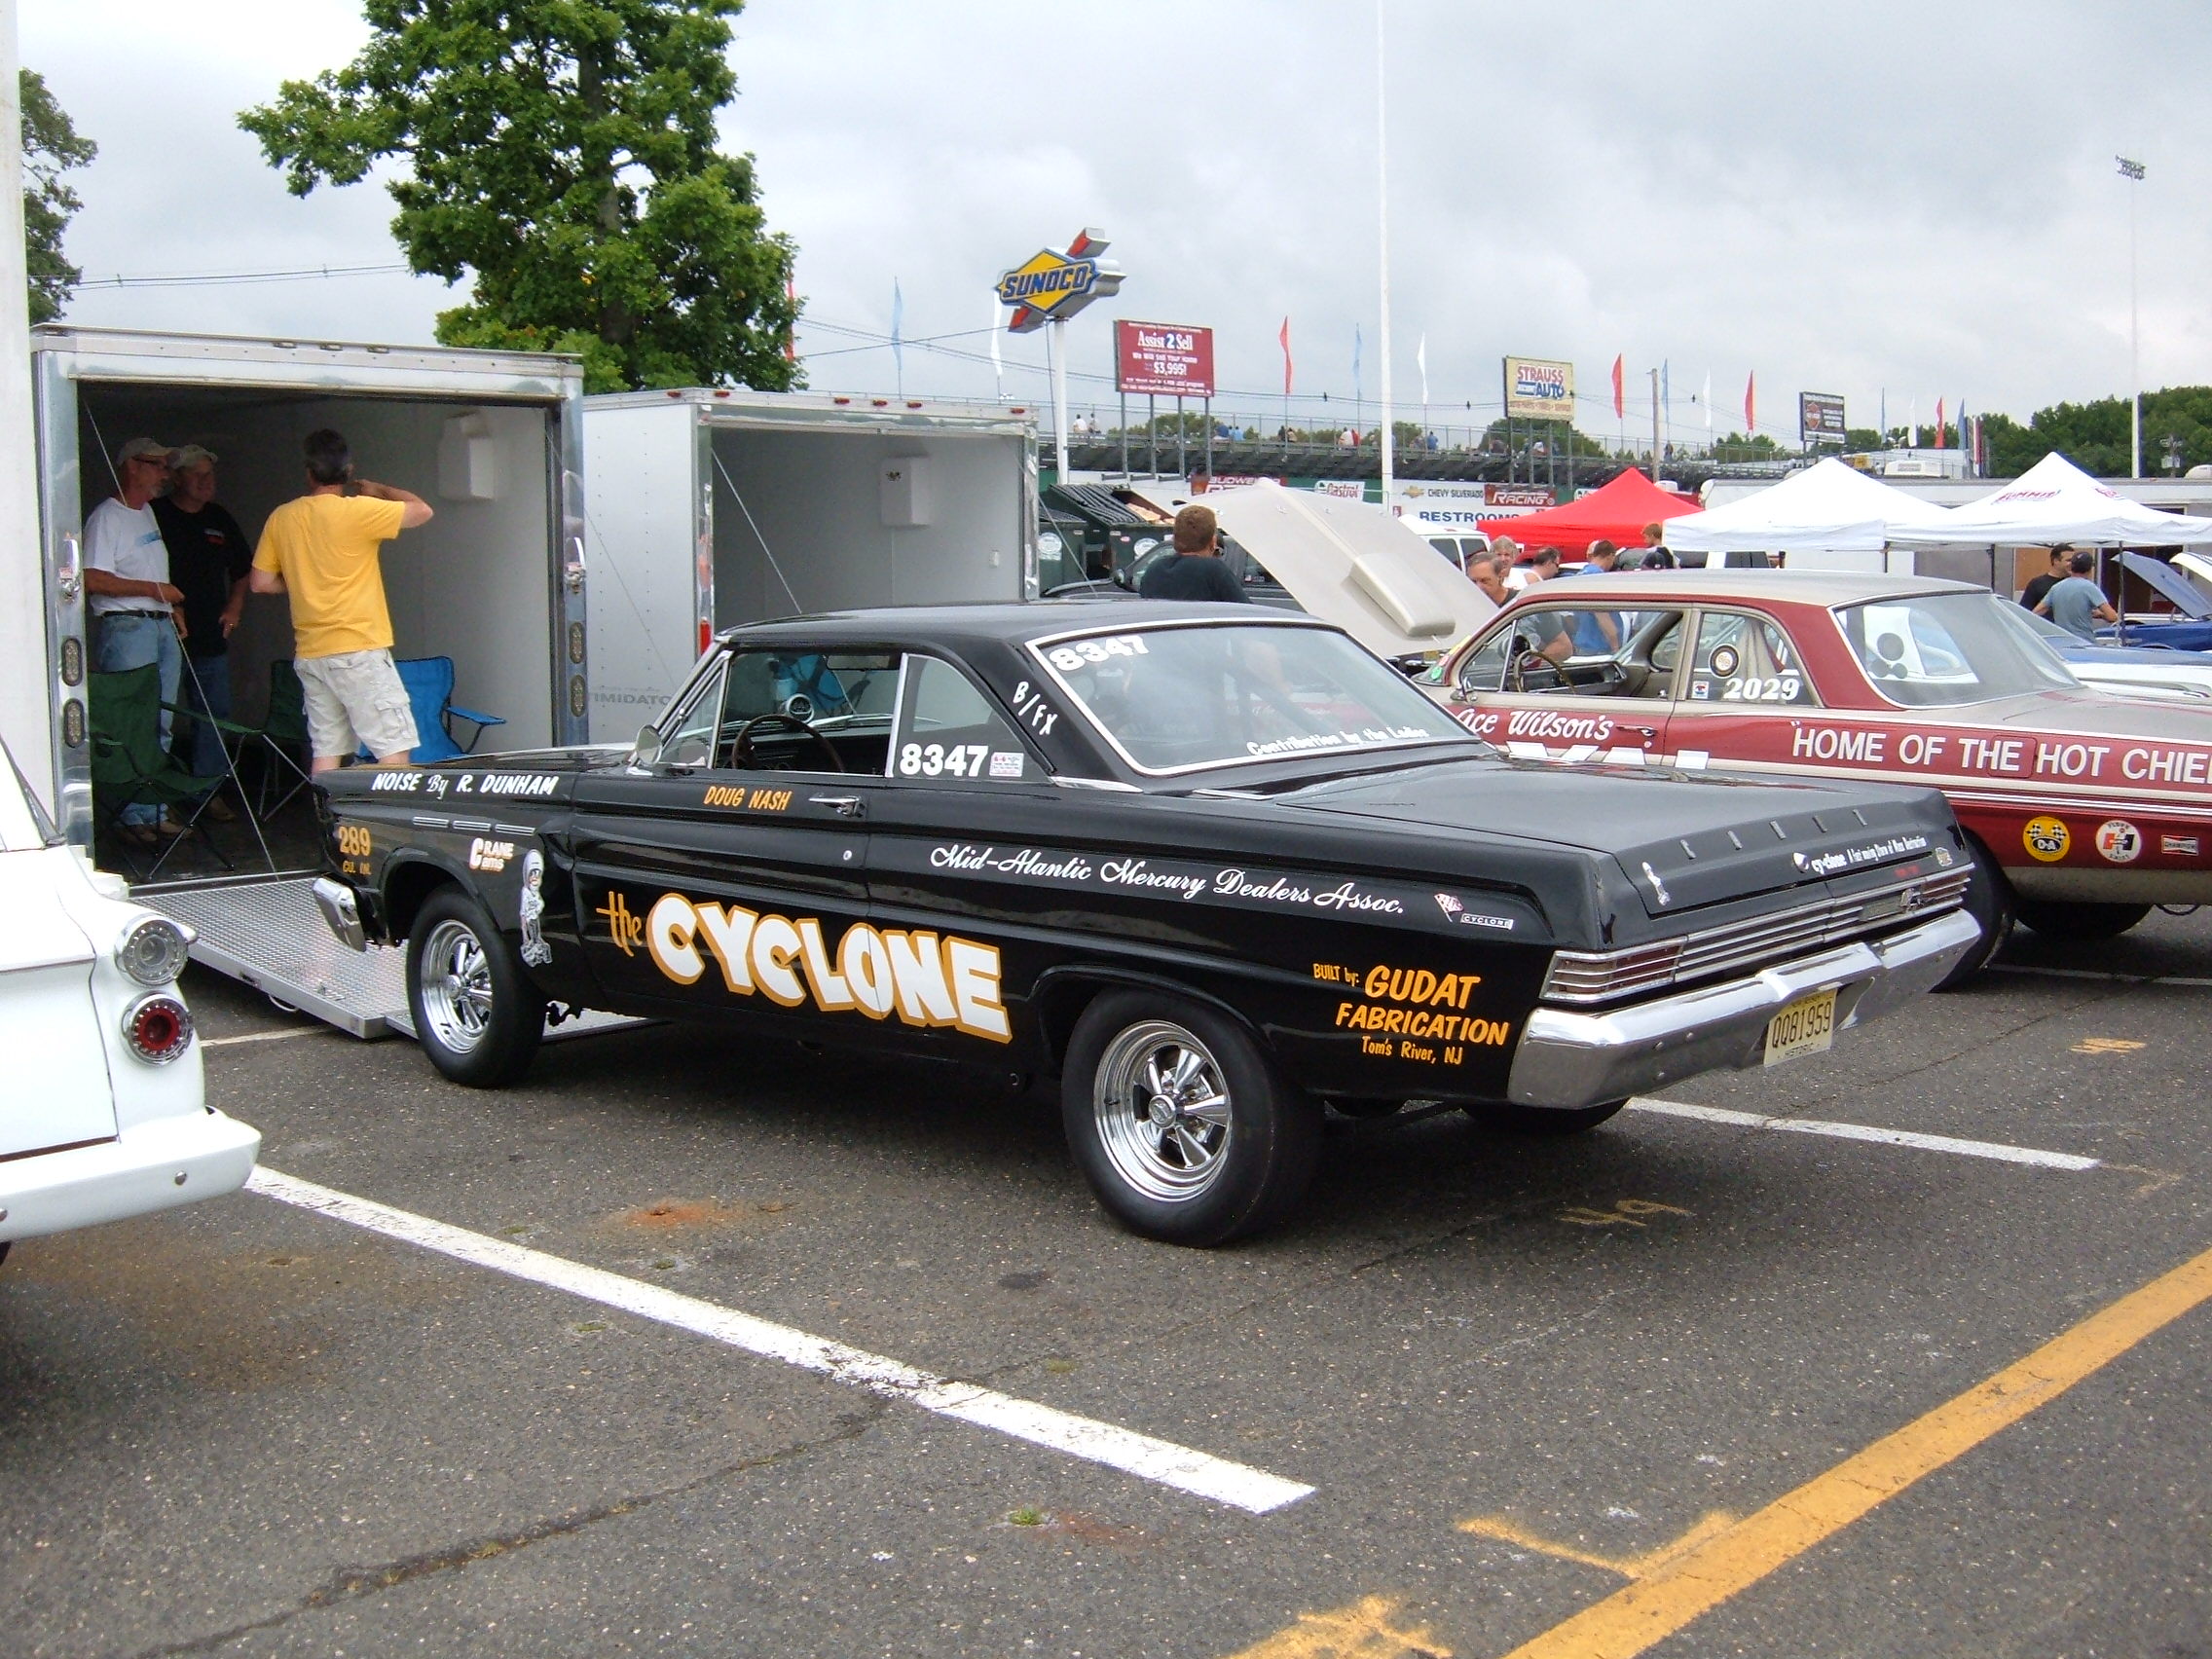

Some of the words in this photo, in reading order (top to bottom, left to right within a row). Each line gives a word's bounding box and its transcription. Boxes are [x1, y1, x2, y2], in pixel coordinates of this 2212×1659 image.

[1003, 264, 1089, 298] SUNOCO
[1137, 330, 1165, 349] Assist
[1165, 333, 1175, 350] 2
[1175, 333, 1194, 350] Sell
[1518, 365, 1565, 386] STRAUSS
[1535, 382, 1565, 400] AUTO
[1427, 488, 1450, 498] CHEVY
[1493, 492, 1548, 504] RACING
[1049, 635, 1149, 671] 8347
[1723, 678, 1800, 701] 2029
[1013, 681, 1058, 735] B/FX
[1508, 710, 1614, 741] Wilson's
[900, 743, 989, 777] 8347
[1899, 734, 1946, 765] OF
[1958, 737, 2023, 772] THE
[2036, 743, 2111, 777] HOT
[2121, 748, 2212, 785] CHIE
[371, 772, 423, 792] NOISE
[425, 774, 449, 800] By
[456, 774, 473, 793] R.
[480, 774, 560, 795] DUNHAM
[703, 786, 746, 807] DOUG
[748, 789, 793, 811] NASH
[338, 826, 371, 856] 289
[1099, 859, 1207, 900] Mercury
[1212, 868, 1311, 903] Dealers
[1313, 882, 1404, 914] Assoc.
[1463, 915, 1510, 928] CYCLONE
[596, 890, 643, 958] the
[645, 892, 1014, 1044] CYCLONE
[1312, 962, 1341, 980] BUILT
[1365, 965, 1481, 1010] GUDAT
[1335, 1002, 1511, 1046] FABRICATION
[1361, 1035, 1393, 1056] Tom's
[1400, 1040, 1437, 1064] River,
[1444, 1047, 1464, 1065] NJ
